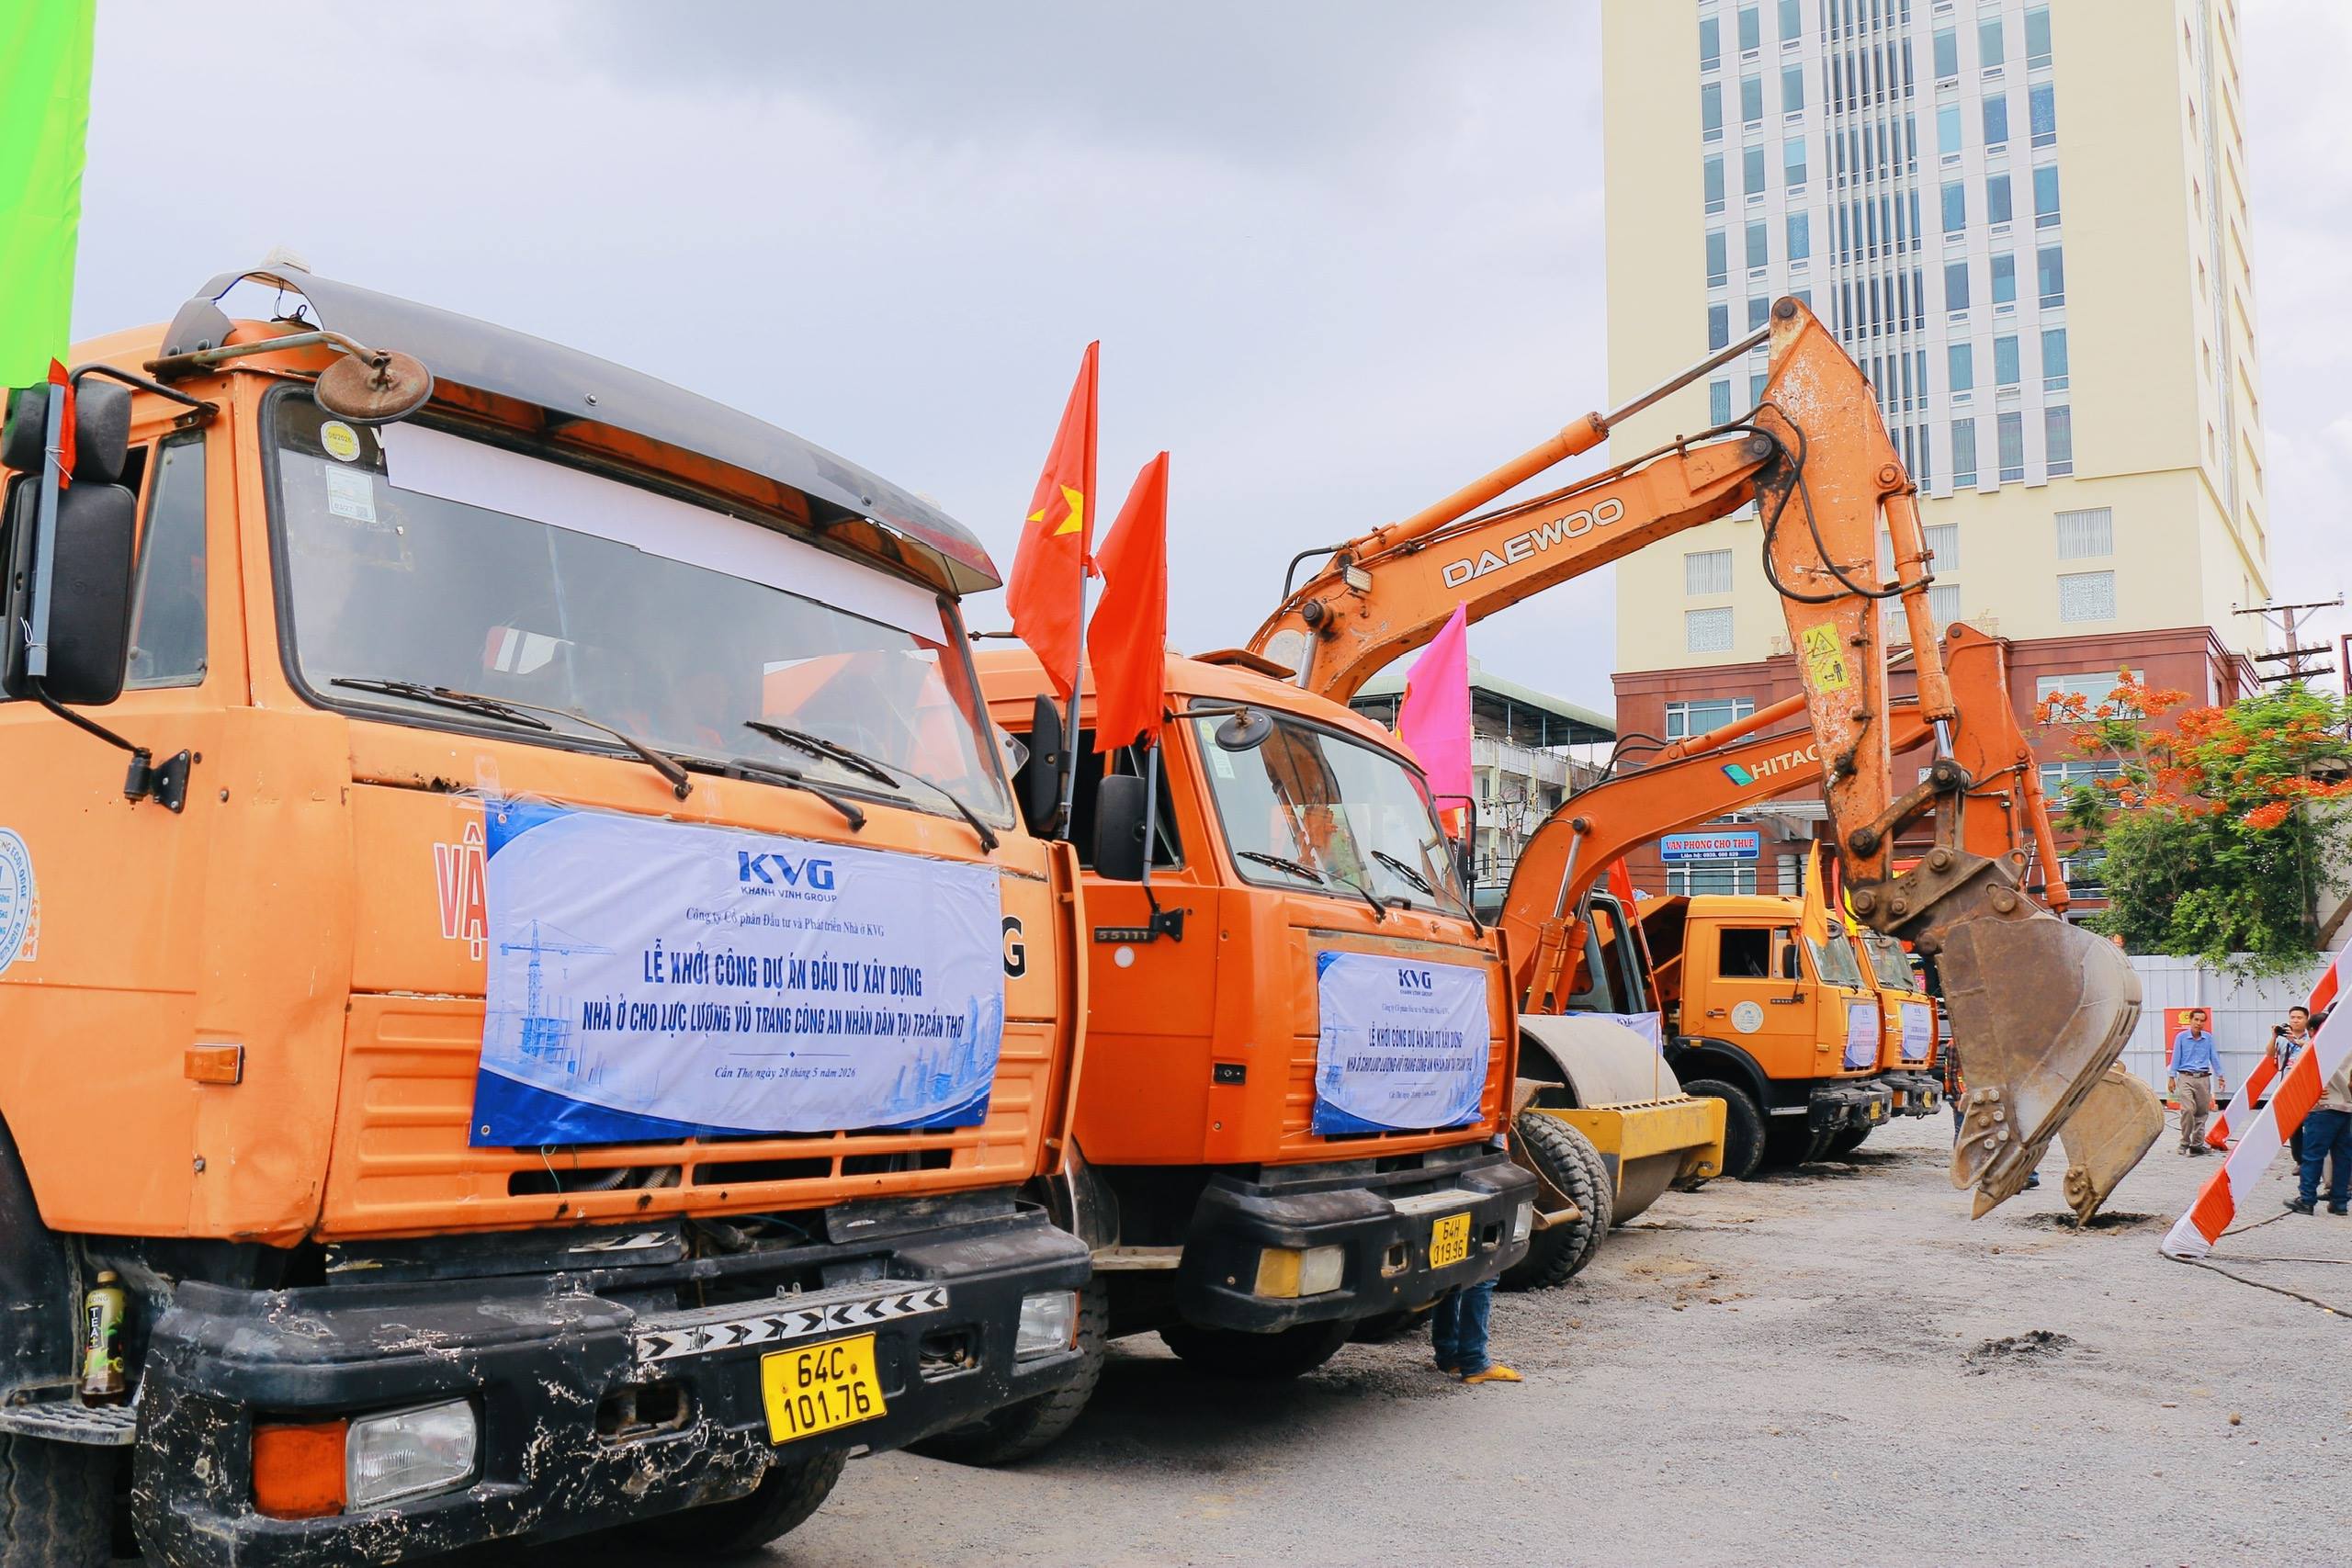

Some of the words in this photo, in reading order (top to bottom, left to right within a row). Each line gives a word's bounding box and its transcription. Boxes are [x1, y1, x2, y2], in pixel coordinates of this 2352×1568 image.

[1442, 497, 1625, 589] DAEWOO
[1750, 744, 1819, 780] HITAC
[1713, 839, 1731, 849] CHO
[738, 851, 835, 890] KVG
[778, 889, 802, 900] VINH
[804, 892, 838, 903] GROUP
[686, 907, 710, 925] Công
[712, 910, 721, 926] ty
[740, 911, 761, 928] phần
[763, 912, 780, 928] Đầu
[782, 917, 791, 929] tư
[793, 917, 802, 930] và
[843, 920, 859, 935] Nhà
[866, 923, 885, 937] KVG
[1001, 916, 1025, 980] G
[644, 938, 664, 984] LỄ
[670, 942, 709, 985] KHỞI
[715, 948, 757, 987] CÔNG
[763, 955, 783, 997] DỰ
[787, 952, 807, 990] ÁN
[811, 951, 838, 991] ĐẦU
[842, 960, 859, 993] TƯ
[863, 958, 887, 994] XÂY
[890, 964, 922, 1003] DỰNG
[1398, 968, 1431, 989] KVG
[582, 995, 611, 1031] NHÀ
[616, 993, 627, 1032] Ở
[629, 1002, 657, 1032] CHO
[661, 1001, 687, 1039] LỰC
[690, 1001, 731, 1039] LƯỢNG
[734, 1000, 752, 1032] VŨ
[756, 1007, 791, 1034] TRANG
[794, 1002, 825, 1035] CÔNG
[827, 1010, 842, 1035] AN
[844, 1005, 873, 1036] NHÂN
[874, 1007, 895, 1036] DÂN
[897, 1012, 911, 1043] TẠI
[945, 1013, 965, 1039] THƠ
[715, 1065, 732, 1077] Cần
[755, 1067, 776, 1080] ngày
[779, 1067, 789, 1077] 28
[790, 1066, 811, 1080] tháng
[812, 1066, 819, 1077] 5
[820, 1067, 837, 1077] năm
[797, 1347, 844, 1388] 64C
[784, 1381, 871, 1433] 101.76
